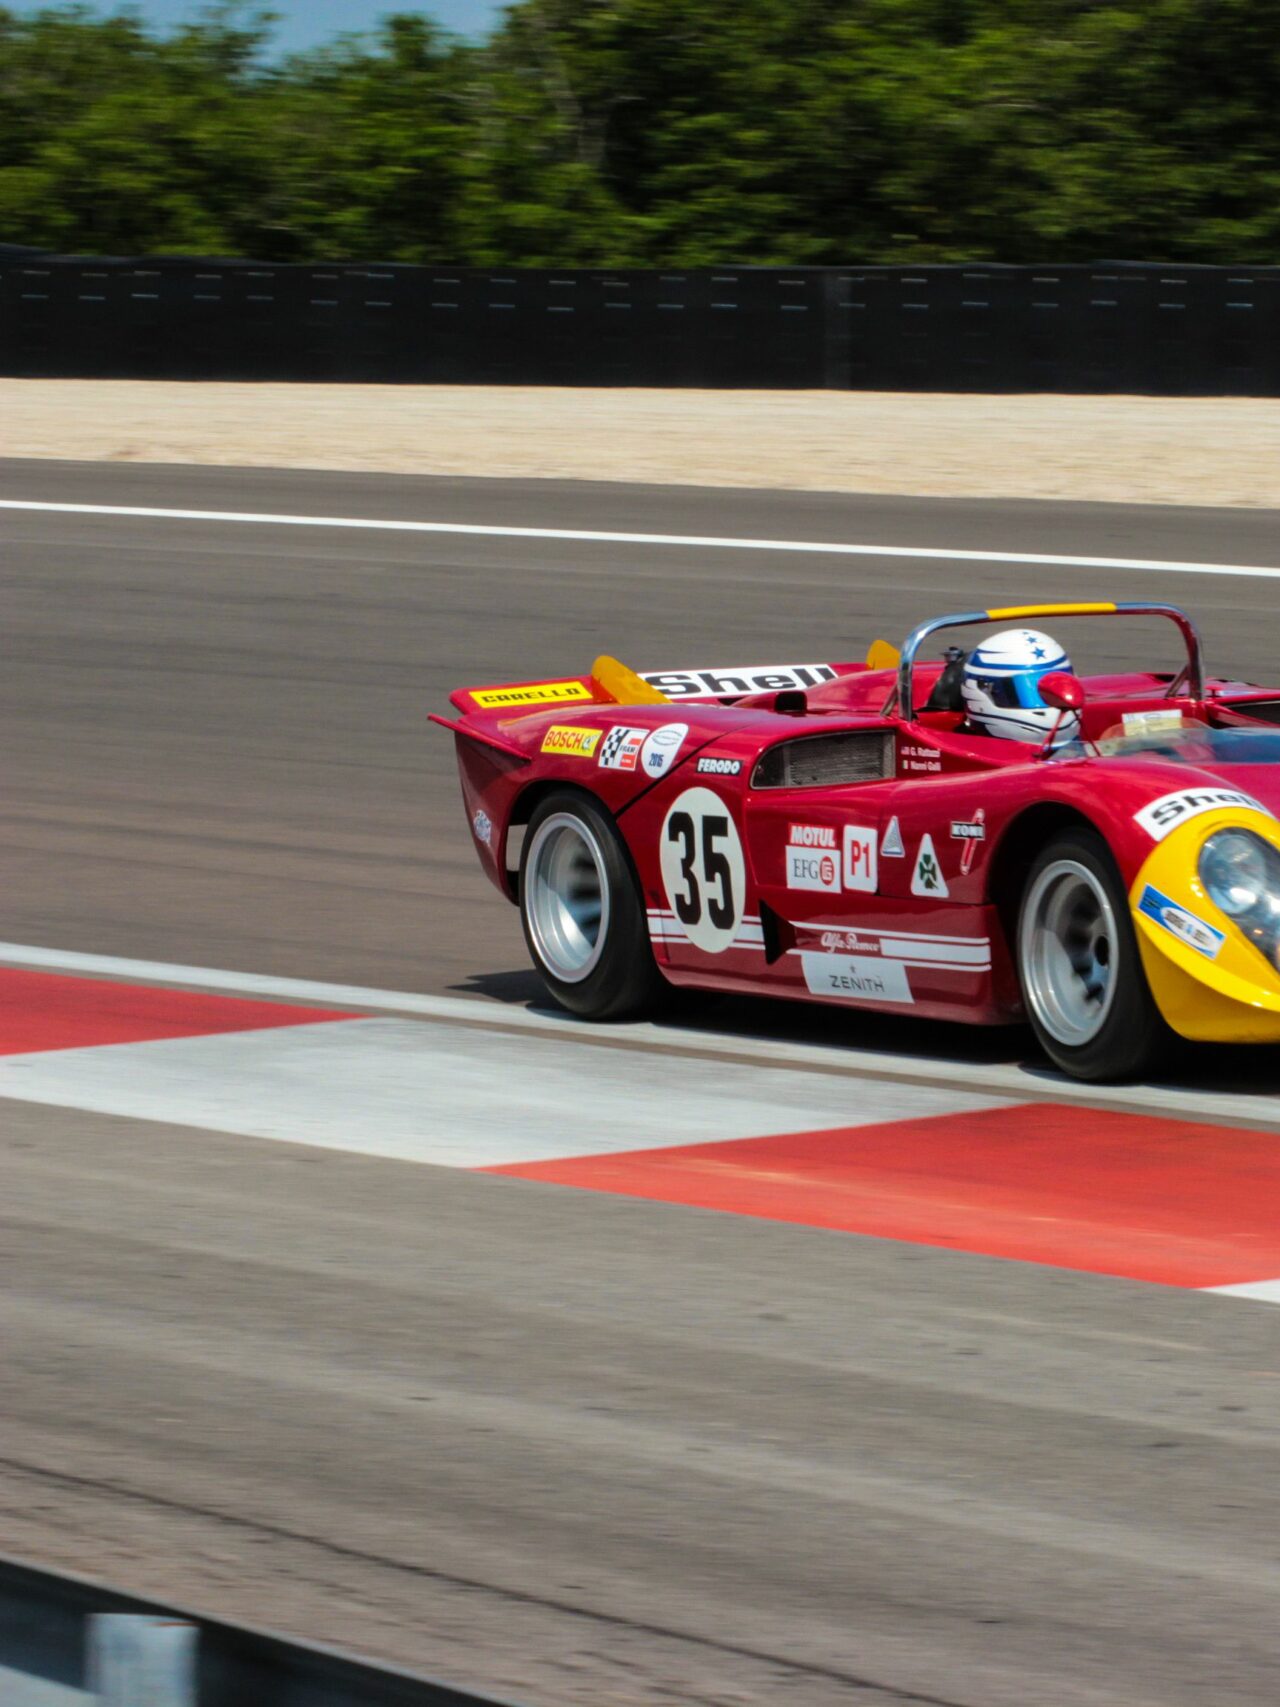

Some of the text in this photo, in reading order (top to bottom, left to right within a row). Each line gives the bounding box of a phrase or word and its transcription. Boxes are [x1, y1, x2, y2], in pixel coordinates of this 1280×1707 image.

[644, 667, 837, 695] Shell
[481, 687, 581, 703] CARELLO
[544, 731, 584, 750] BOSCH
[697, 758, 741, 775] FERODO
[790, 825, 836, 847] MOTUL
[952, 823, 984, 838] KONI
[793, 858, 818, 880] EFG
[851, 839, 871, 879] P1
[667, 811, 736, 930] 35
[828, 974, 886, 993] ZENITH
